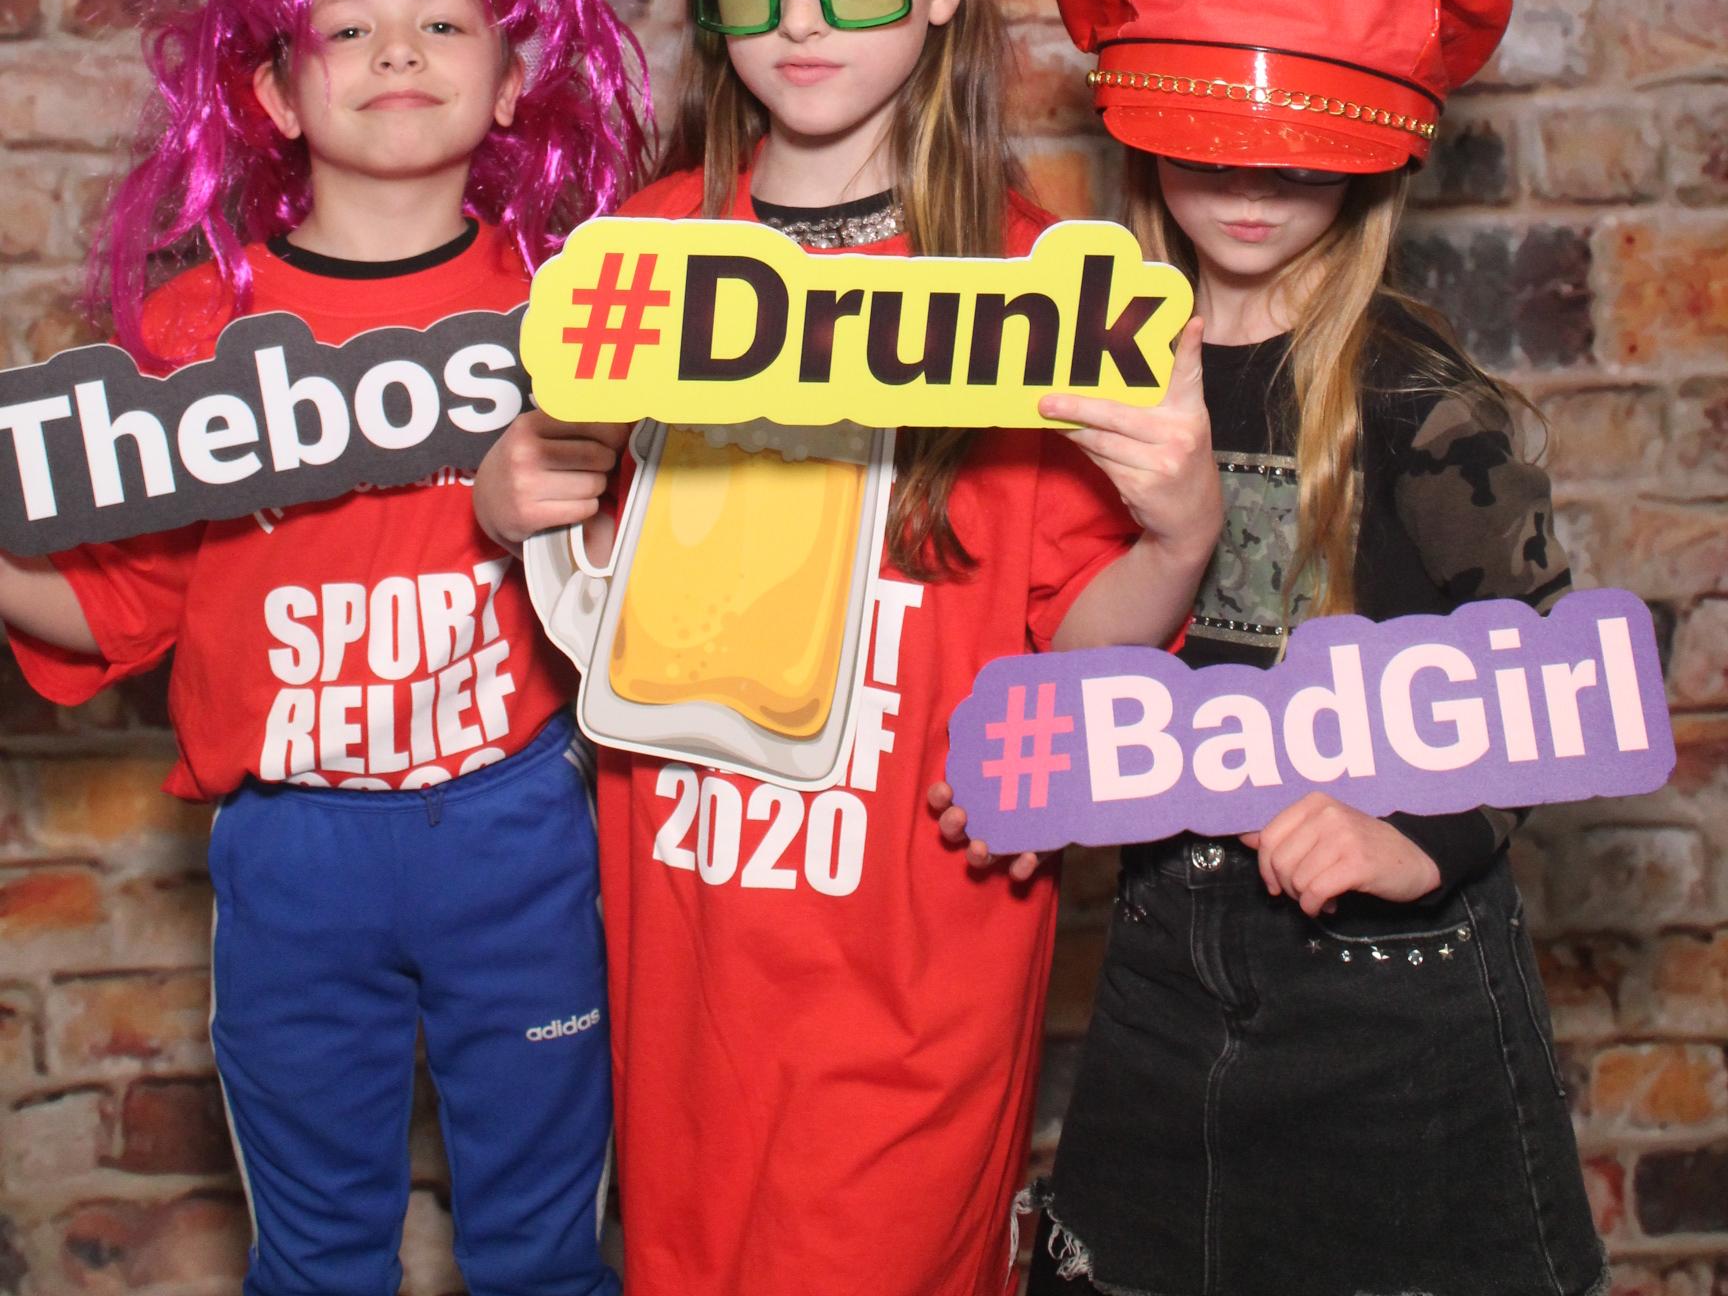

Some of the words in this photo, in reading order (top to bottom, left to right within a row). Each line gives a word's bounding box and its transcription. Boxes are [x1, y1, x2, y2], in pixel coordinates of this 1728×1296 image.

[561, 251, 1168, 388] #Drunk
[263, 556, 513, 686] SPORT
[259, 639, 516, 781] RELIEF
[981, 616, 1650, 812] #BadGirl
[652, 762, 868, 897] 2020
[525, 1008, 600, 1041] adidas
